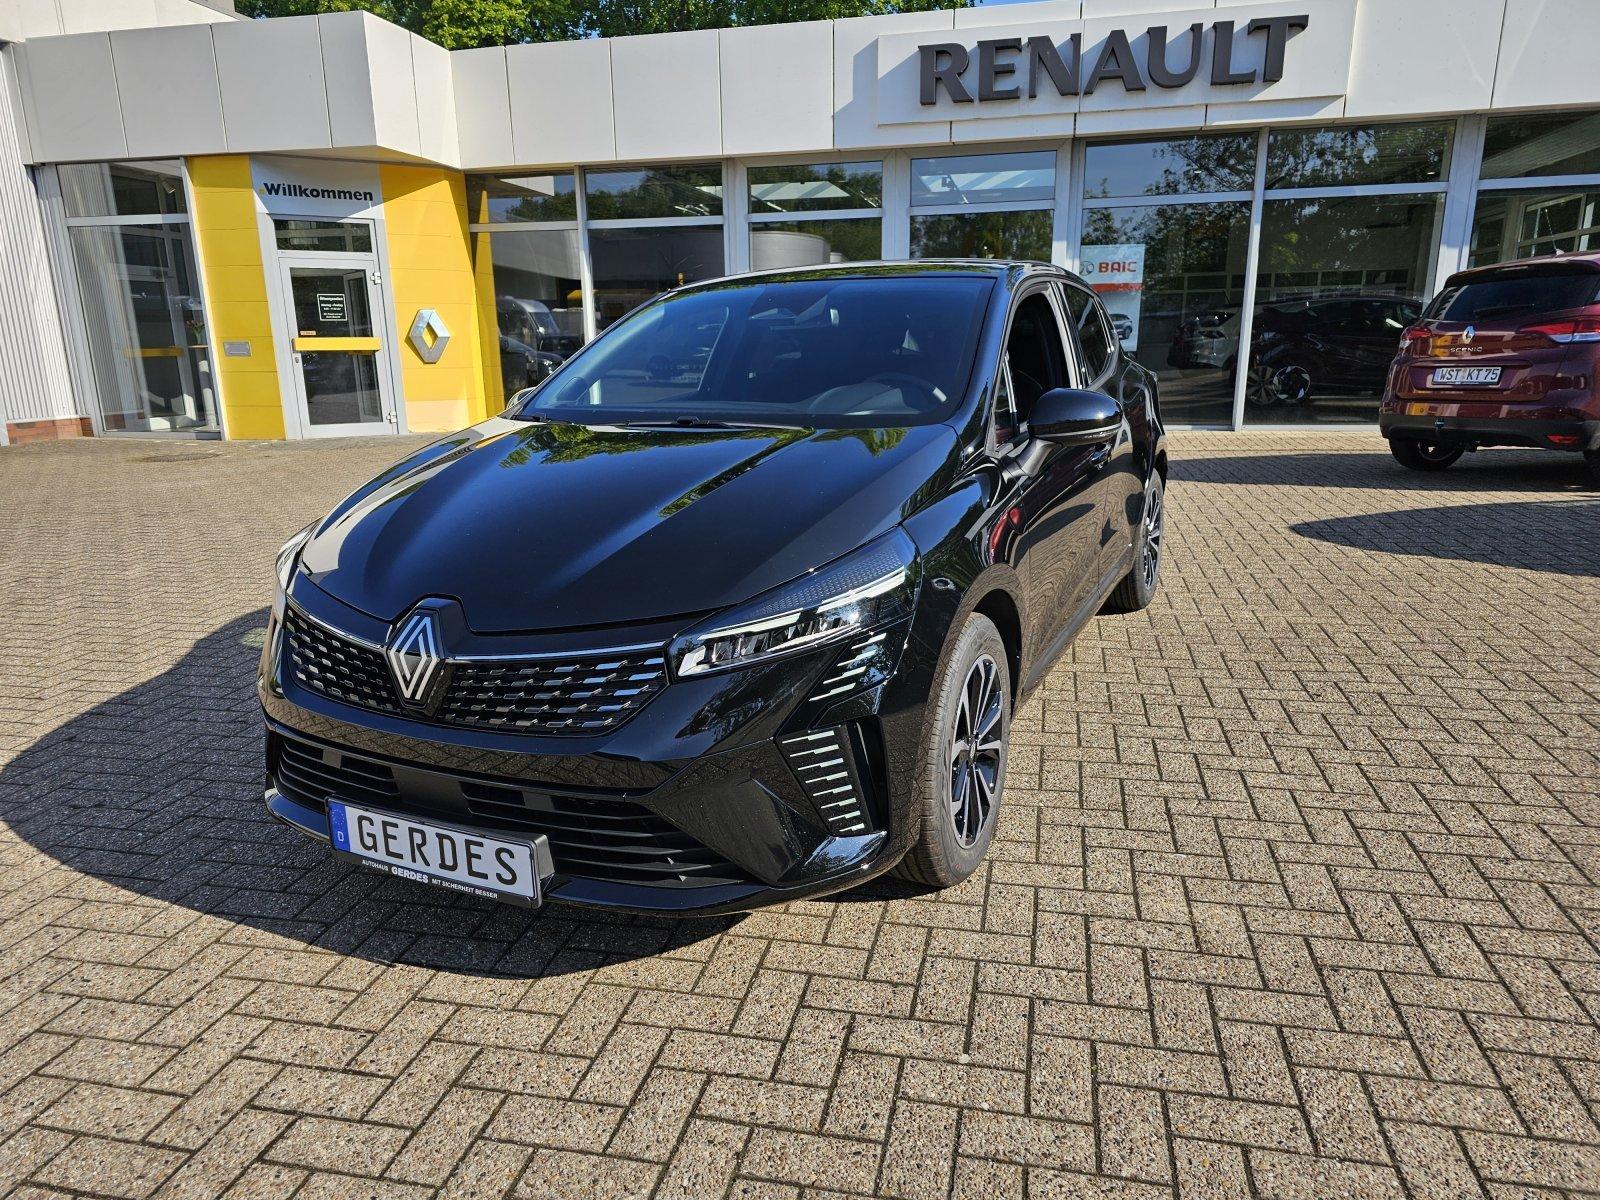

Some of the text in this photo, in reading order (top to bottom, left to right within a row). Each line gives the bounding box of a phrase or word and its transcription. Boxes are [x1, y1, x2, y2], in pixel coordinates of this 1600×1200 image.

[918, 14, 1309, 105] RENAULT
[263, 183, 373, 201] Willkommen
[1099, 262, 1136, 272] BAIC
[1440, 369, 1499, 380] WST KT 75
[337, 831, 344, 842] D
[357, 815, 517, 885] GERDES
[361, 859, 389, 872] AUTOHAUS
[391, 866, 429, 884] GERDES
[442, 881, 474, 894] SICHERHEIT
[475, 888, 498, 899] BESSER
